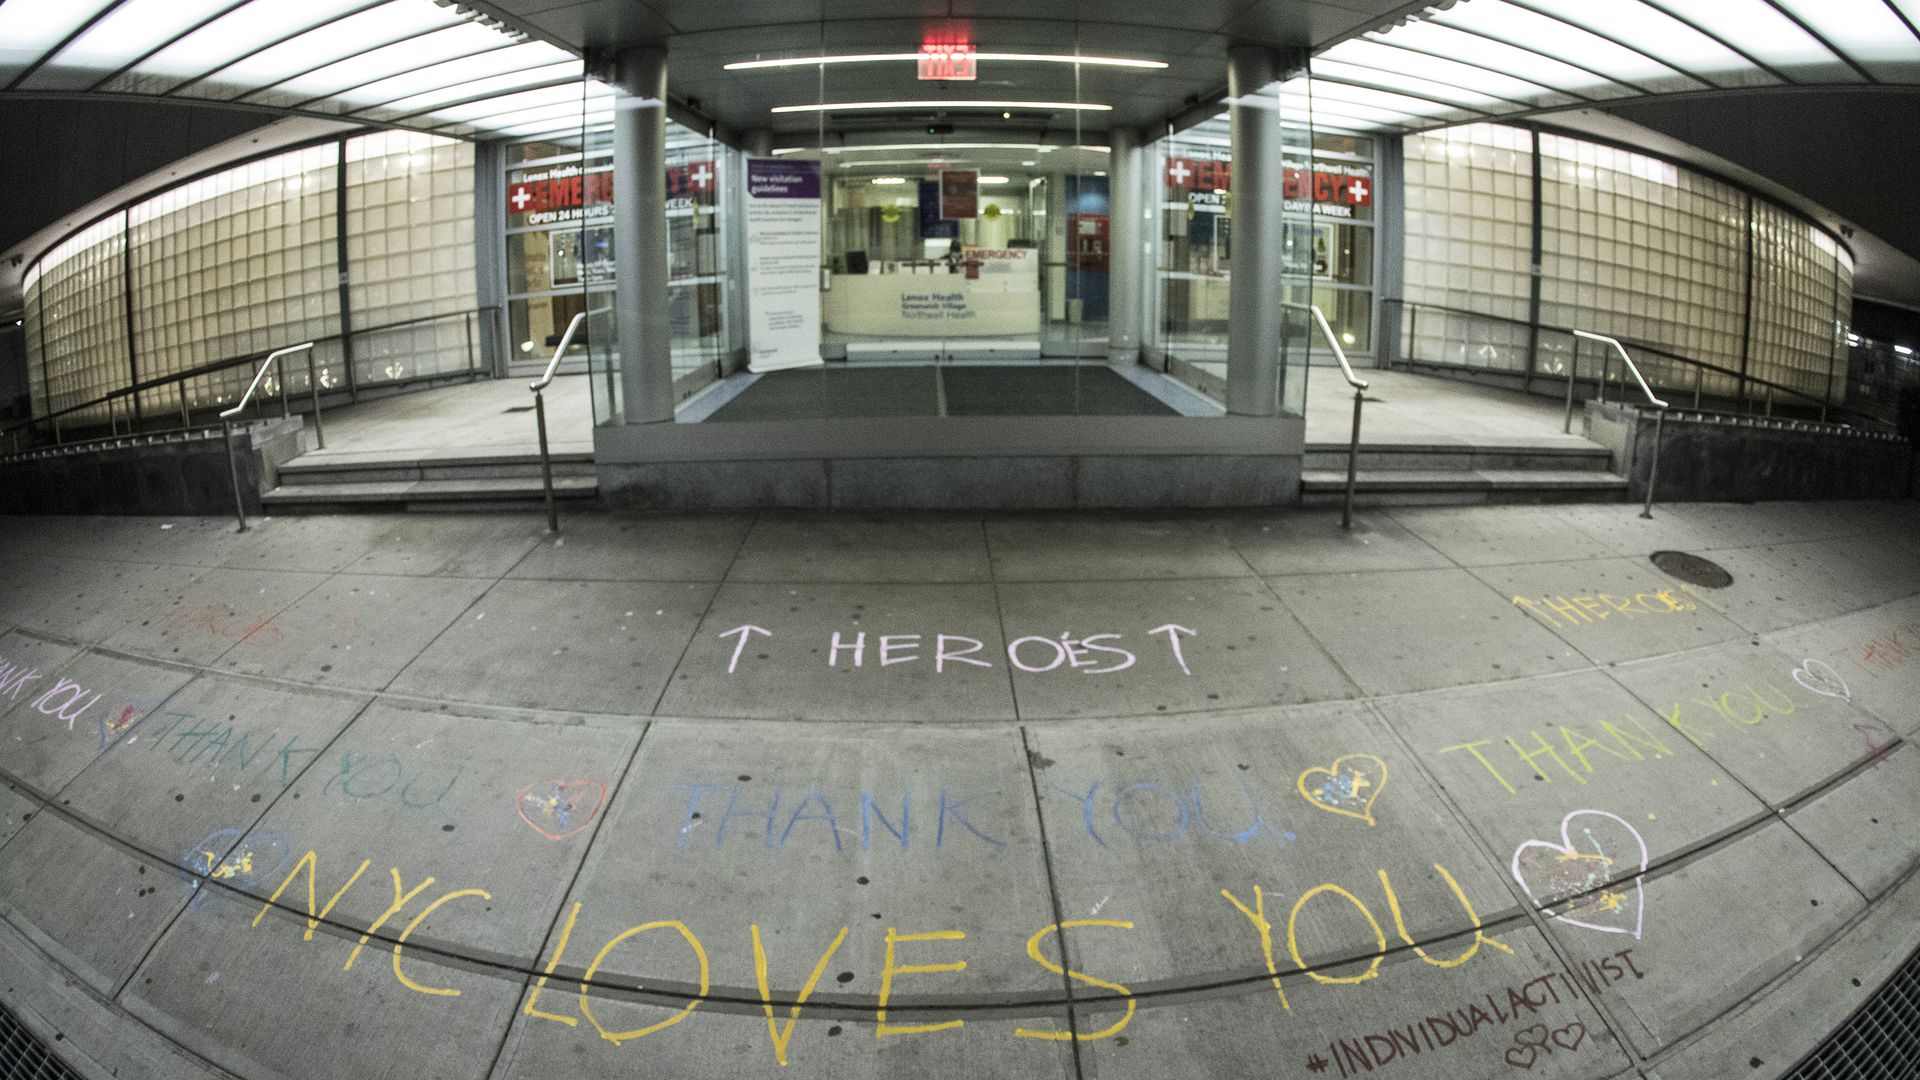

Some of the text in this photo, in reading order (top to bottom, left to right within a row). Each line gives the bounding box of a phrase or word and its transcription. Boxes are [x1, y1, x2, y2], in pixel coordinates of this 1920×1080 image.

[528, 211, 557, 225] OPEN
[558, 209, 571, 221] 24
[931, 293, 964, 301] Health
[828, 631, 1137, 675] HEROES
[30, 677, 101, 731] YOU
[150, 711, 466, 809] THANK YOU
[1440, 682, 1796, 795] THANK YOU
[672, 777, 1297, 851] THANK YOU
[251, 850, 1515, 1068] NYC LOVES YOU
